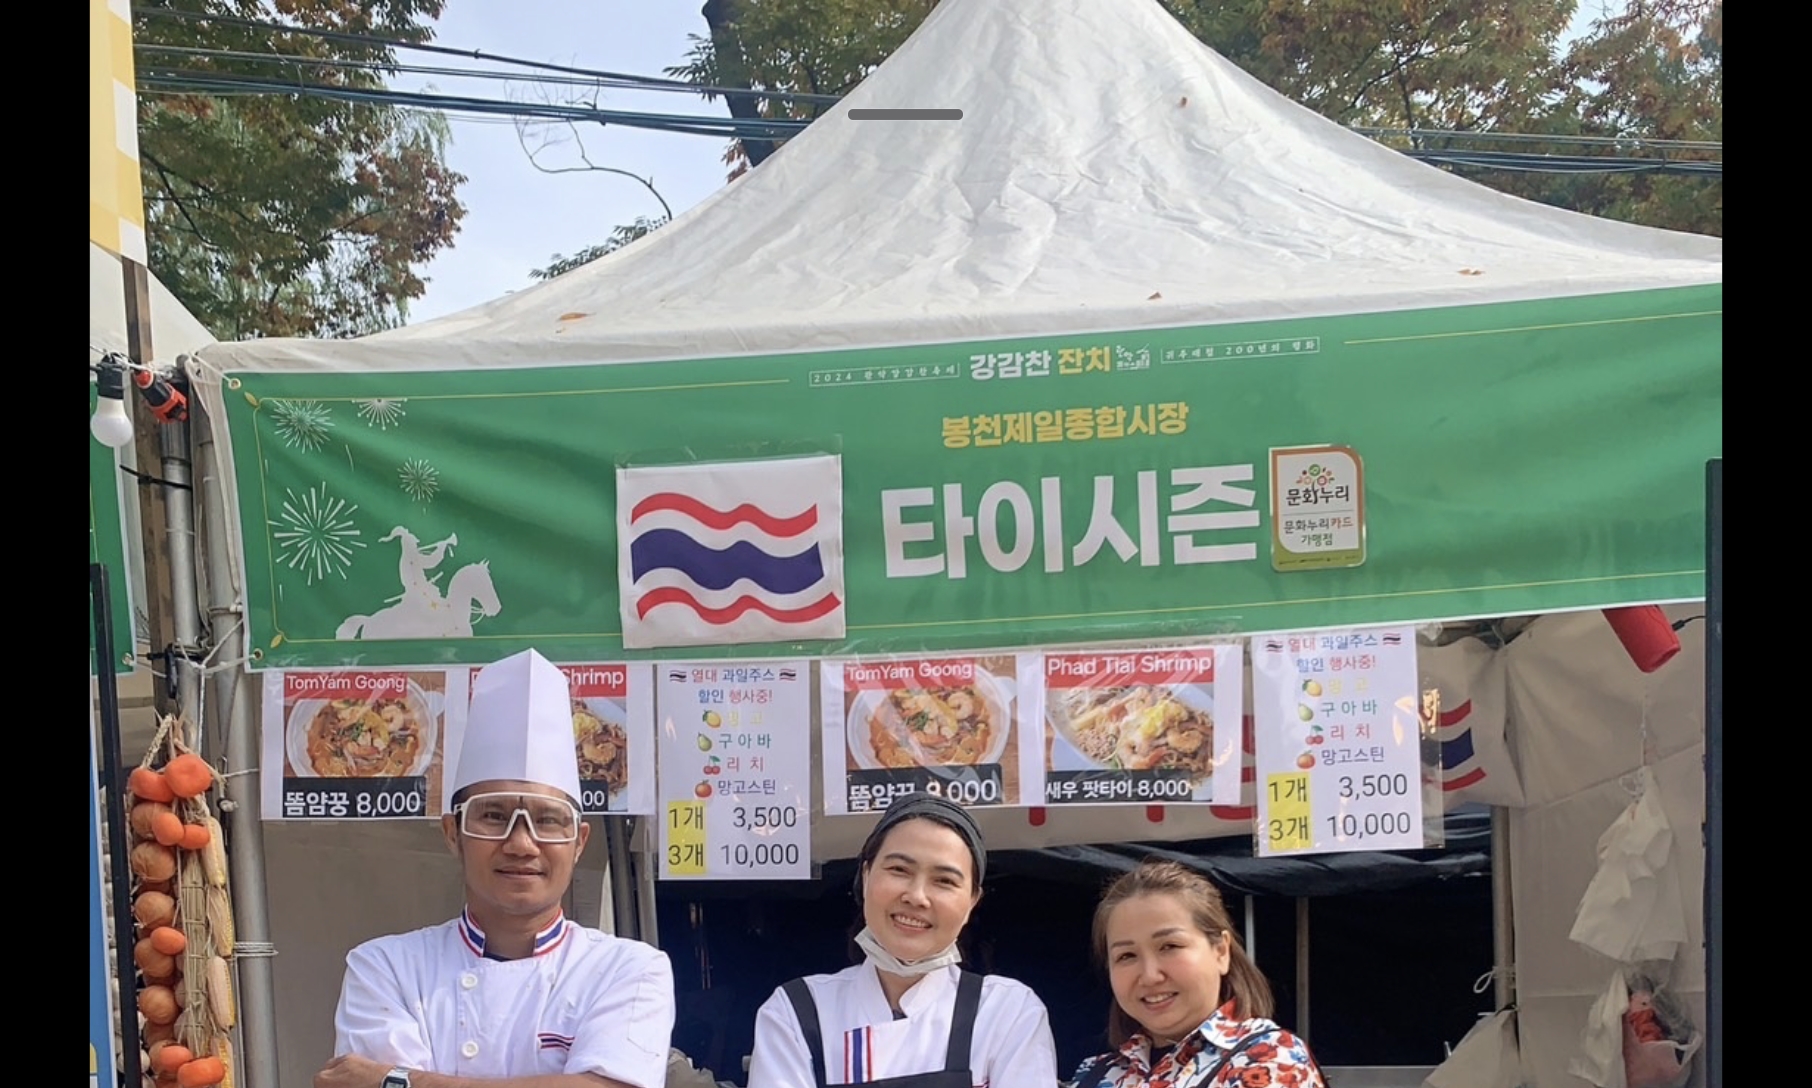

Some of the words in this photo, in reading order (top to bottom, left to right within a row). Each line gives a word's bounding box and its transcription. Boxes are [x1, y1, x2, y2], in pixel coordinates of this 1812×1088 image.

[970, 350, 1052, 380] 강감찬
[1057, 346, 1111, 375] 잔치
[814, 372, 852, 383] 2024
[942, 402, 1189, 448] 봉천제일종합시장
[1286, 484, 1349, 507] 문화누리
[881, 463, 1260, 579] 타이시즌
[1284, 517, 1354, 534] 문화누리카드
[1301, 533, 1333, 547] 가맹점
[1288, 636, 1316, 653] 열대
[1321, 634, 1378, 650] 과일주스
[846, 664, 915, 681] TomYam
[918, 662, 973, 679] Goong
[1048, 658, 1097, 675] Phad
[1141, 655, 1212, 676] Shrimp
[1297, 657, 1324, 673] 할인
[1329, 654, 1376, 671] 행사중!
[286, 674, 351, 690] TomYam
[355, 674, 405, 693] Goong
[692, 669, 718, 683] 열대
[722, 668, 775, 683] 과일주스
[698, 689, 724, 704] 할인
[729, 688, 773, 704] 행사중!
[1322, 747, 1384, 766] 망고스틴
[718, 780, 776, 795] 망고스틴
[1045, 781, 1078, 799] 새우
[1082, 779, 1132, 799] 팟타이
[1137, 779, 1190, 799] 8,000
[1268, 778, 1308, 802] 1개
[1338, 773, 1408, 800] 3,500
[284, 791, 350, 816] 똠얌꿍
[356, 791, 420, 817] 8,000
[669, 806, 704, 830] 1개
[733, 806, 796, 831] 3,500
[1269, 815, 1309, 842] 3개
[1327, 812, 1411, 839] 10,000
[669, 843, 704, 867] 3개
[721, 844, 799, 868] 10,000
